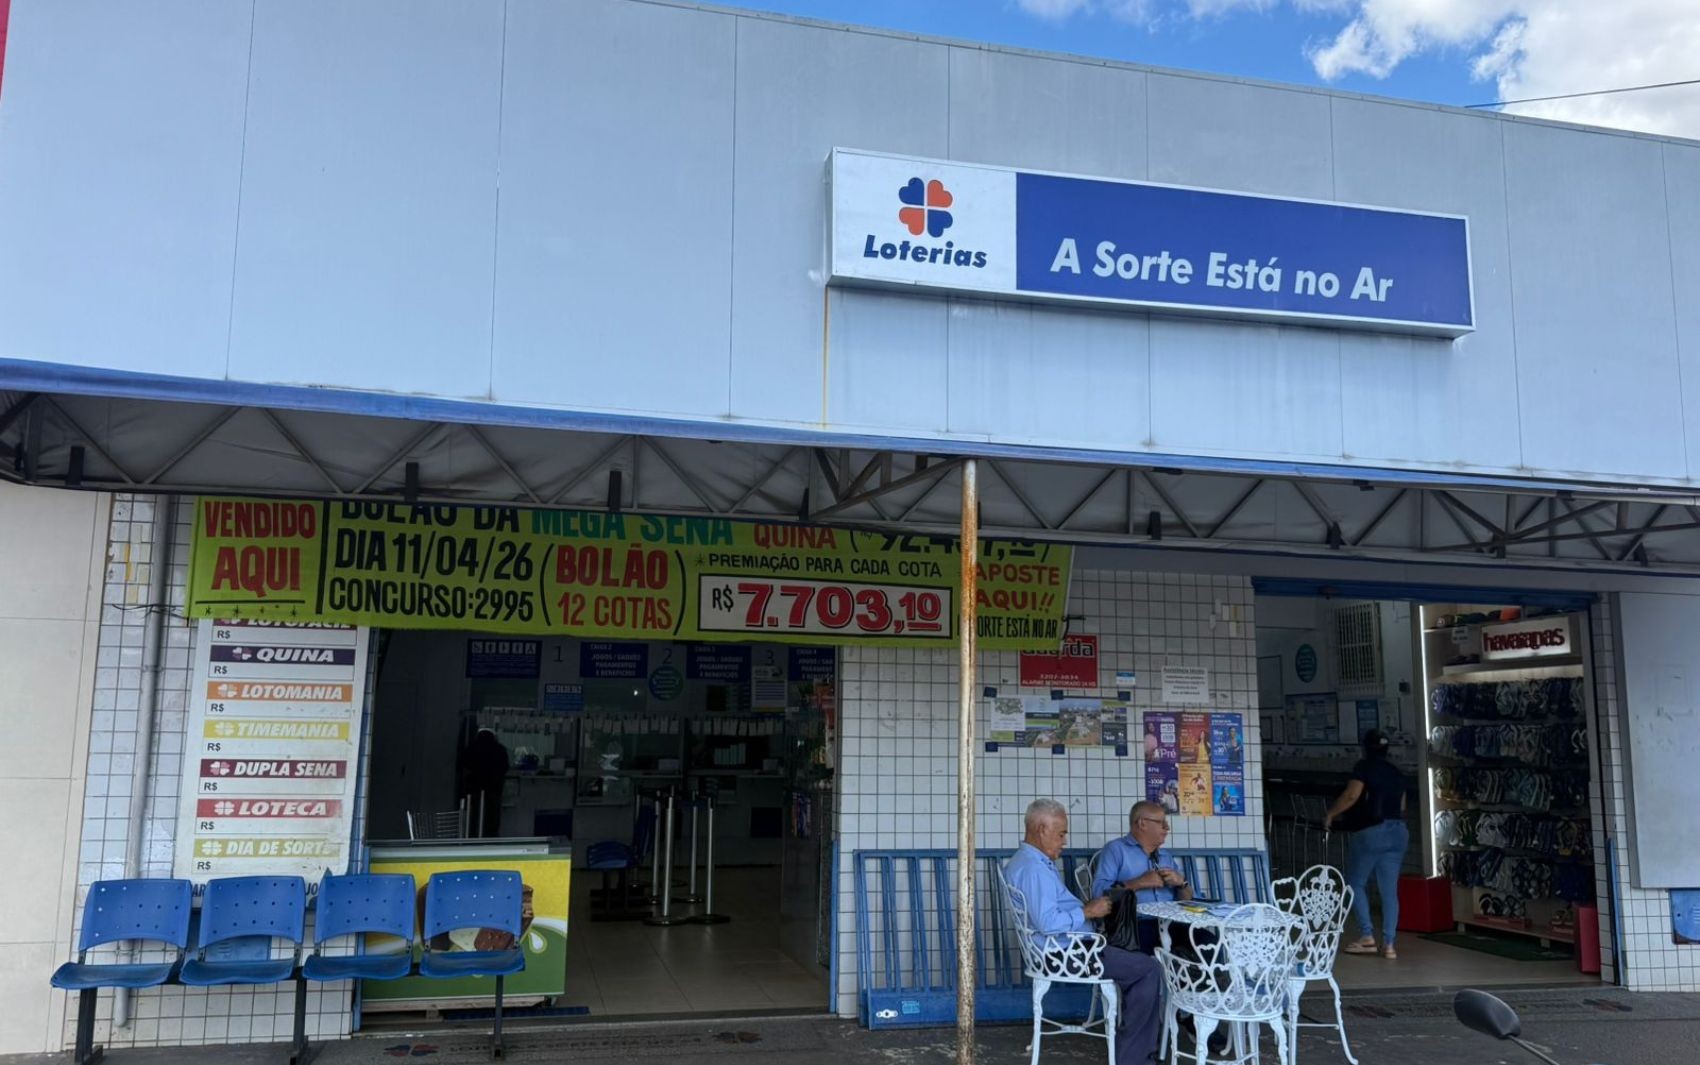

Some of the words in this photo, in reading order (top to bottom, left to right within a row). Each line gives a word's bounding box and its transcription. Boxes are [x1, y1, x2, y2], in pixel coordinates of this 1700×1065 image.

[864, 235, 987, 269] Loterias
[1050, 238, 1081, 274] A
[1093, 242, 1192, 285] Sorte
[1207, 252, 1280, 293] Está
[1295, 271, 1340, 299] no
[1351, 266, 1394, 302] Ar
[205, 501, 315, 539] VENDIDO
[640, 514, 734, 546] SENA
[754, 524, 837, 550] QUINA
[335, 528, 387, 572] DIA
[392, 531, 533, 584] 11/04/26
[211, 545, 300, 598] AQUI
[556, 543, 668, 591] BOLÃO
[709, 552, 799, 573] PREMIAÇÃO
[806, 556, 844, 575] PARA
[851, 559, 890, 577] CADA
[899, 561, 942, 579] COTA
[976, 562, 1060, 585] APOSTE
[329, 576, 534, 623] CONCURSO:2995
[976, 588, 1055, 613] AQUI!!
[558, 592, 586, 627] 12
[594, 595, 673, 631] COTAS
[712, 584, 735, 612] R$
[738, 582, 943, 635] 7.703,10
[217, 630, 231, 639] R$
[977, 616, 1004, 638] ORTE
[1006, 613, 1030, 638] ESTÁ
[1045, 620, 1058, 639] AR
[256, 648, 335, 663] QUINA
[552, 646, 563, 662] 1
[662, 648, 673, 665] 2
[214, 665, 228, 675] R$
[241, 683, 343, 700] LOTOMANIA
[210, 703, 224, 713] R$
[237, 721, 340, 738] TIMEMANIA
[207, 742, 221, 752] R$
[234, 762, 290, 777] DUPLA
[294, 762, 337, 777] SENA
[204, 782, 217, 792] R$
[238, 801, 327, 816] LOTECA
[200, 821, 214, 831] R$
[226, 841, 254, 856] DIA
[258, 841, 279, 856] DE
[197, 860, 211, 871] R$
